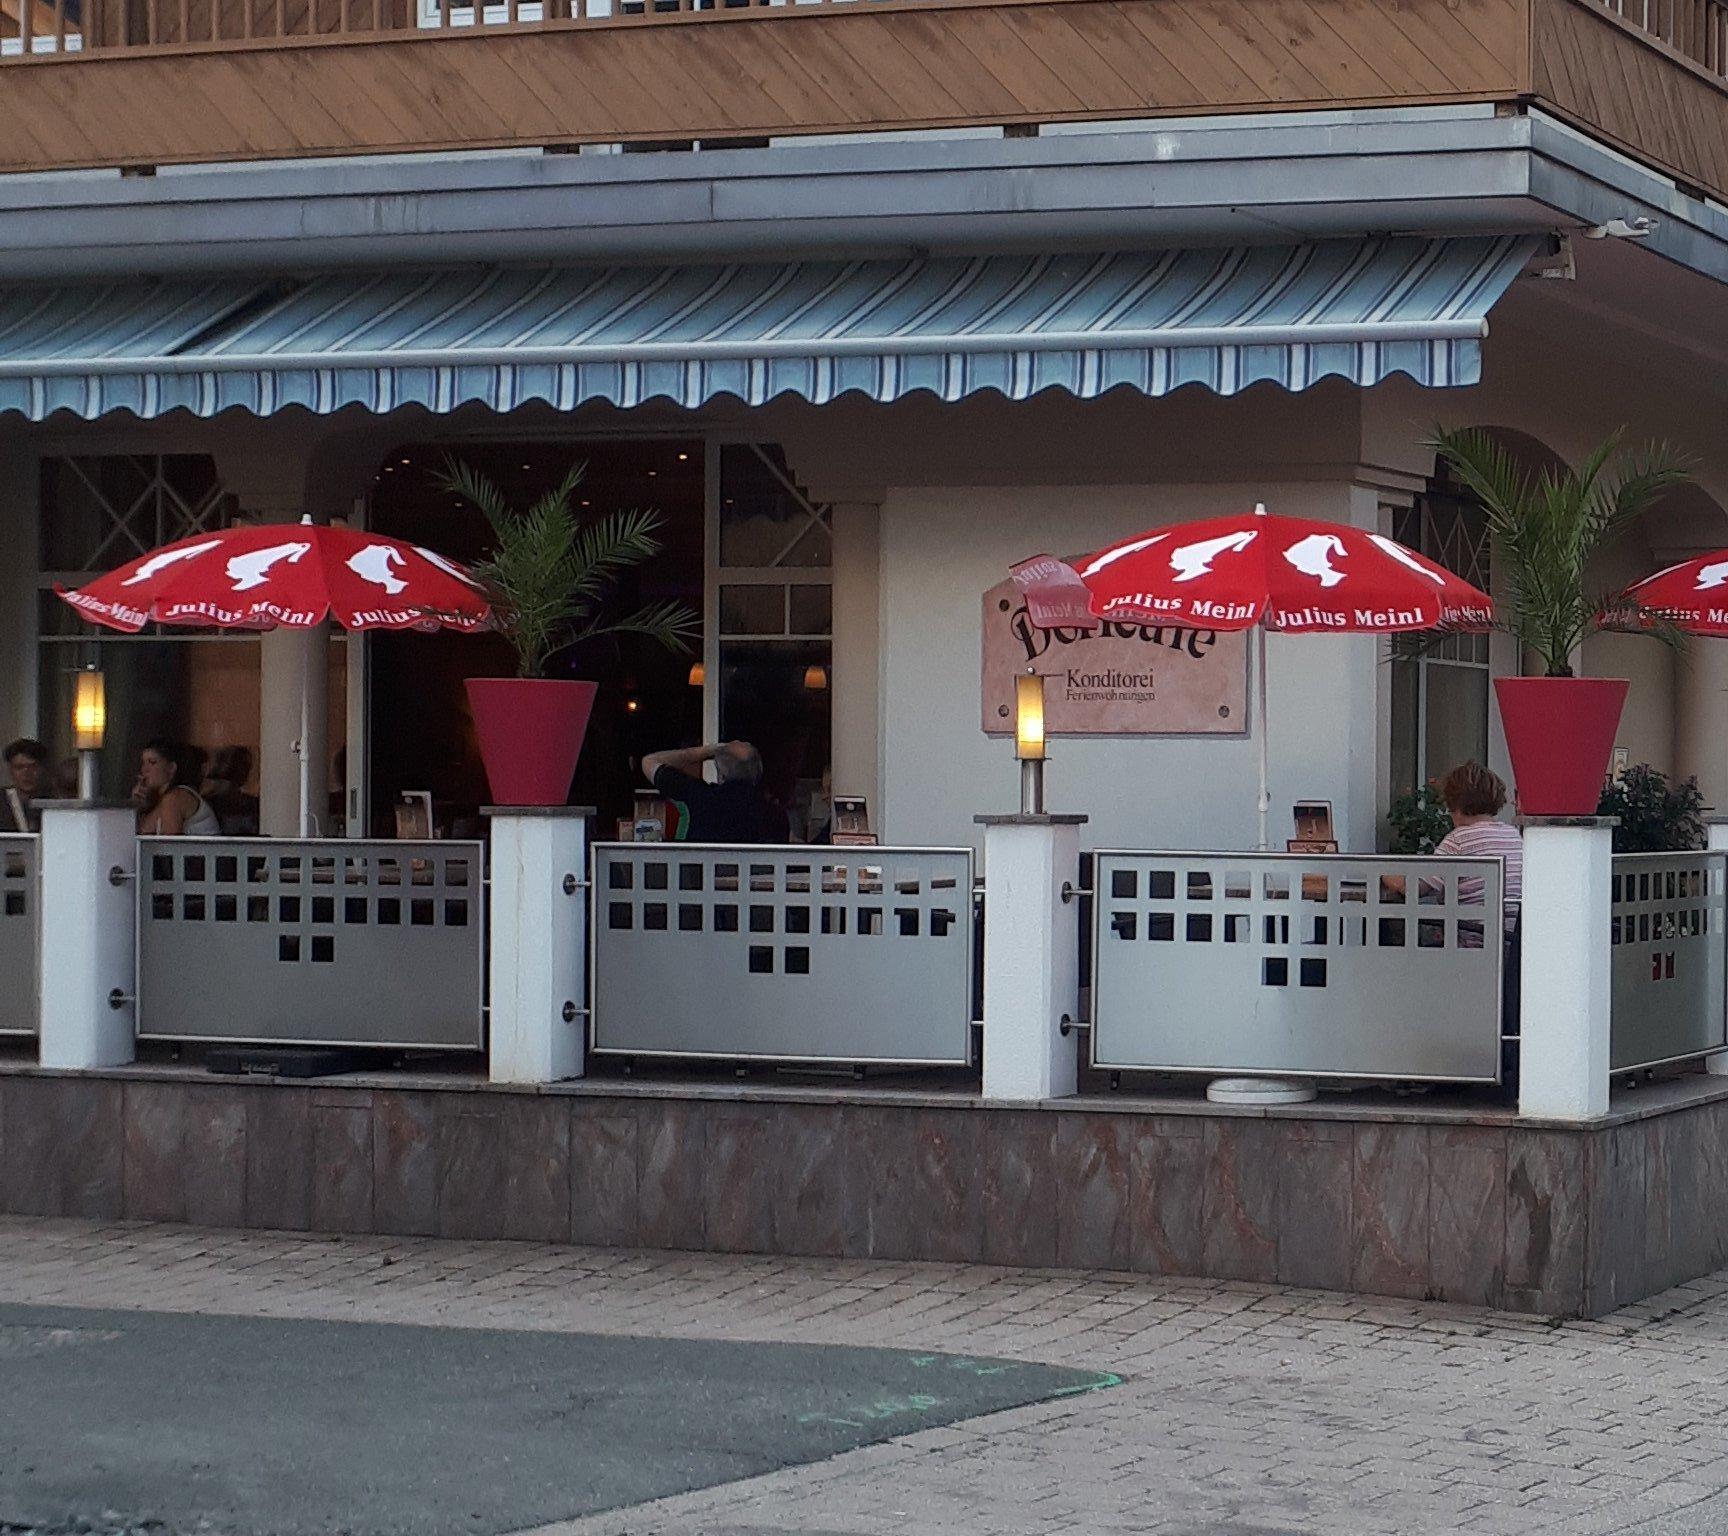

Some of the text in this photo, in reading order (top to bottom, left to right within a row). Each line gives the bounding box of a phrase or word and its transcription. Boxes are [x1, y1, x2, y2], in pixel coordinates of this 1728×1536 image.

[165, 601, 315, 625] Julius Meinl
[1103, 593, 1255, 620] Julius Meinl
[1275, 606, 1347, 627] Julius
[1354, 607, 1424, 627] Meinl
[351, 608, 421, 627] Julius
[1066, 668, 1154, 688] Konditorei
